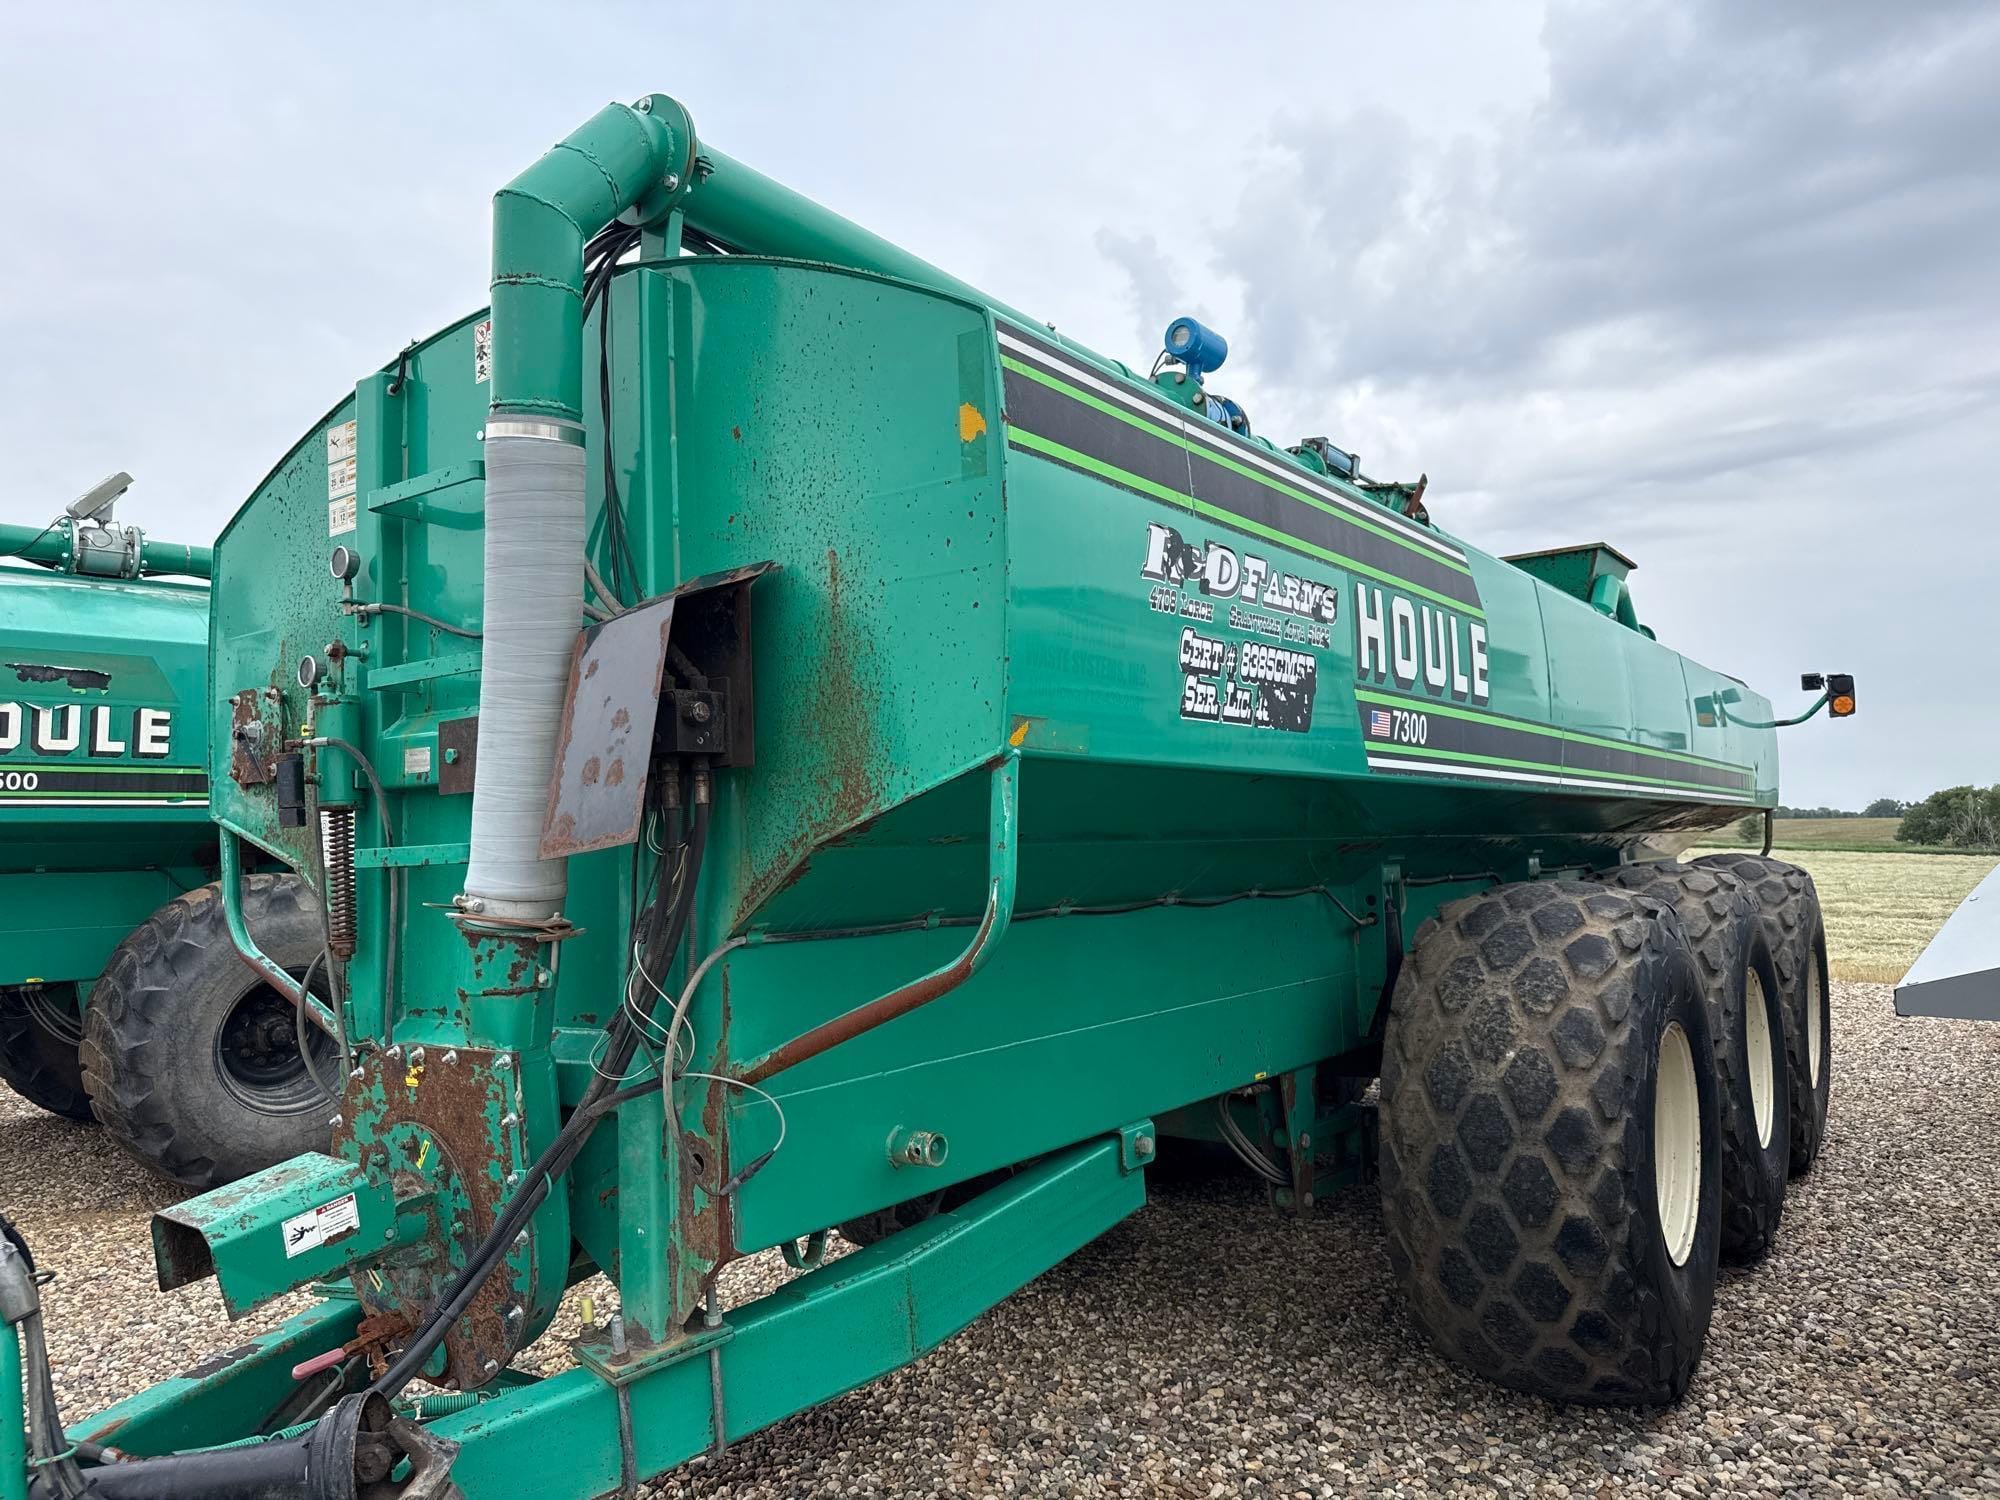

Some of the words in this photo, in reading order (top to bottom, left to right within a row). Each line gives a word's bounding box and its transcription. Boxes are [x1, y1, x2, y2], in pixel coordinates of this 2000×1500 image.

[1180, 626, 1225, 678] CERT
[1226, 642, 1238, 679] #
[1357, 582, 1489, 706] HOULE
[1392, 709, 1428, 745] 7300
